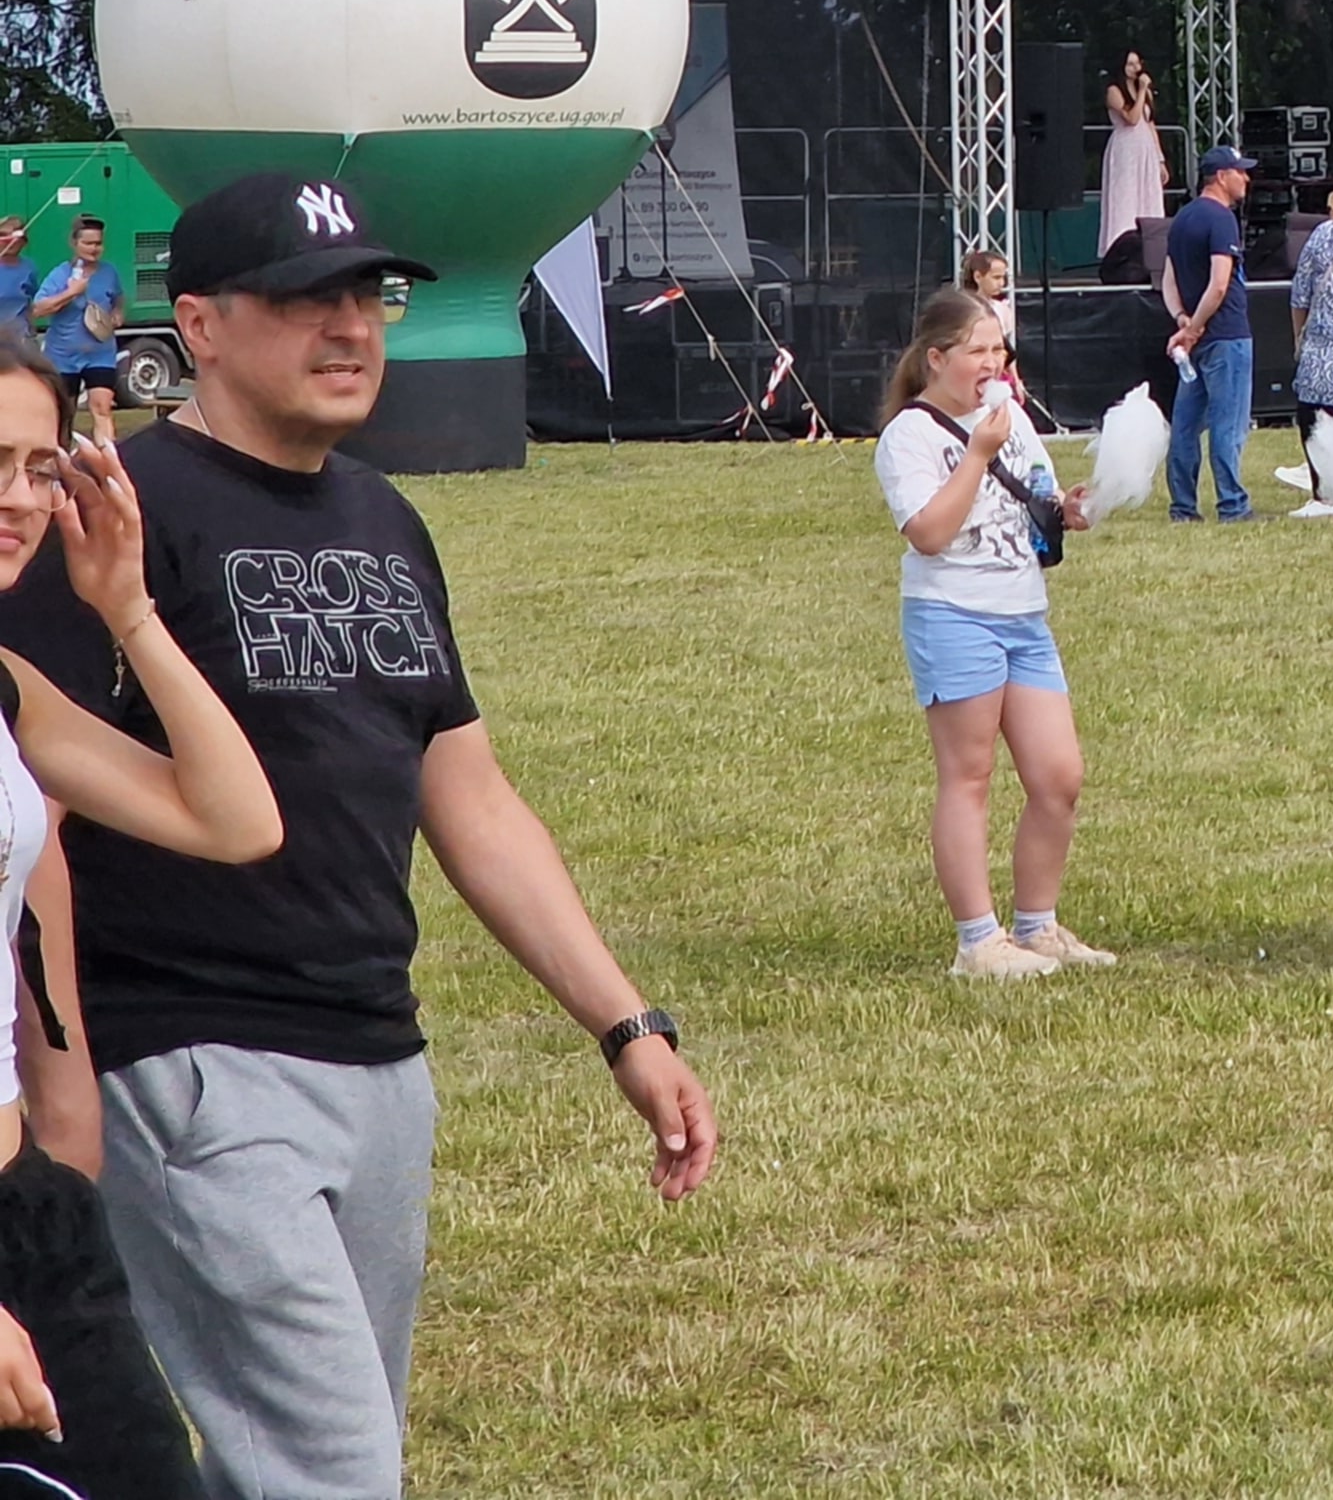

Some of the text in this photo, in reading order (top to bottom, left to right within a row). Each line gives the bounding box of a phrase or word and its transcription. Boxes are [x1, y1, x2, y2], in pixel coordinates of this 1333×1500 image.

[401, 107, 625, 127] www.bartoszyce.ug.gov.pl
[296, 184, 355, 235] NY
[225, 549, 423, 613] CROSS
[242, 612, 450, 678] HATCH
